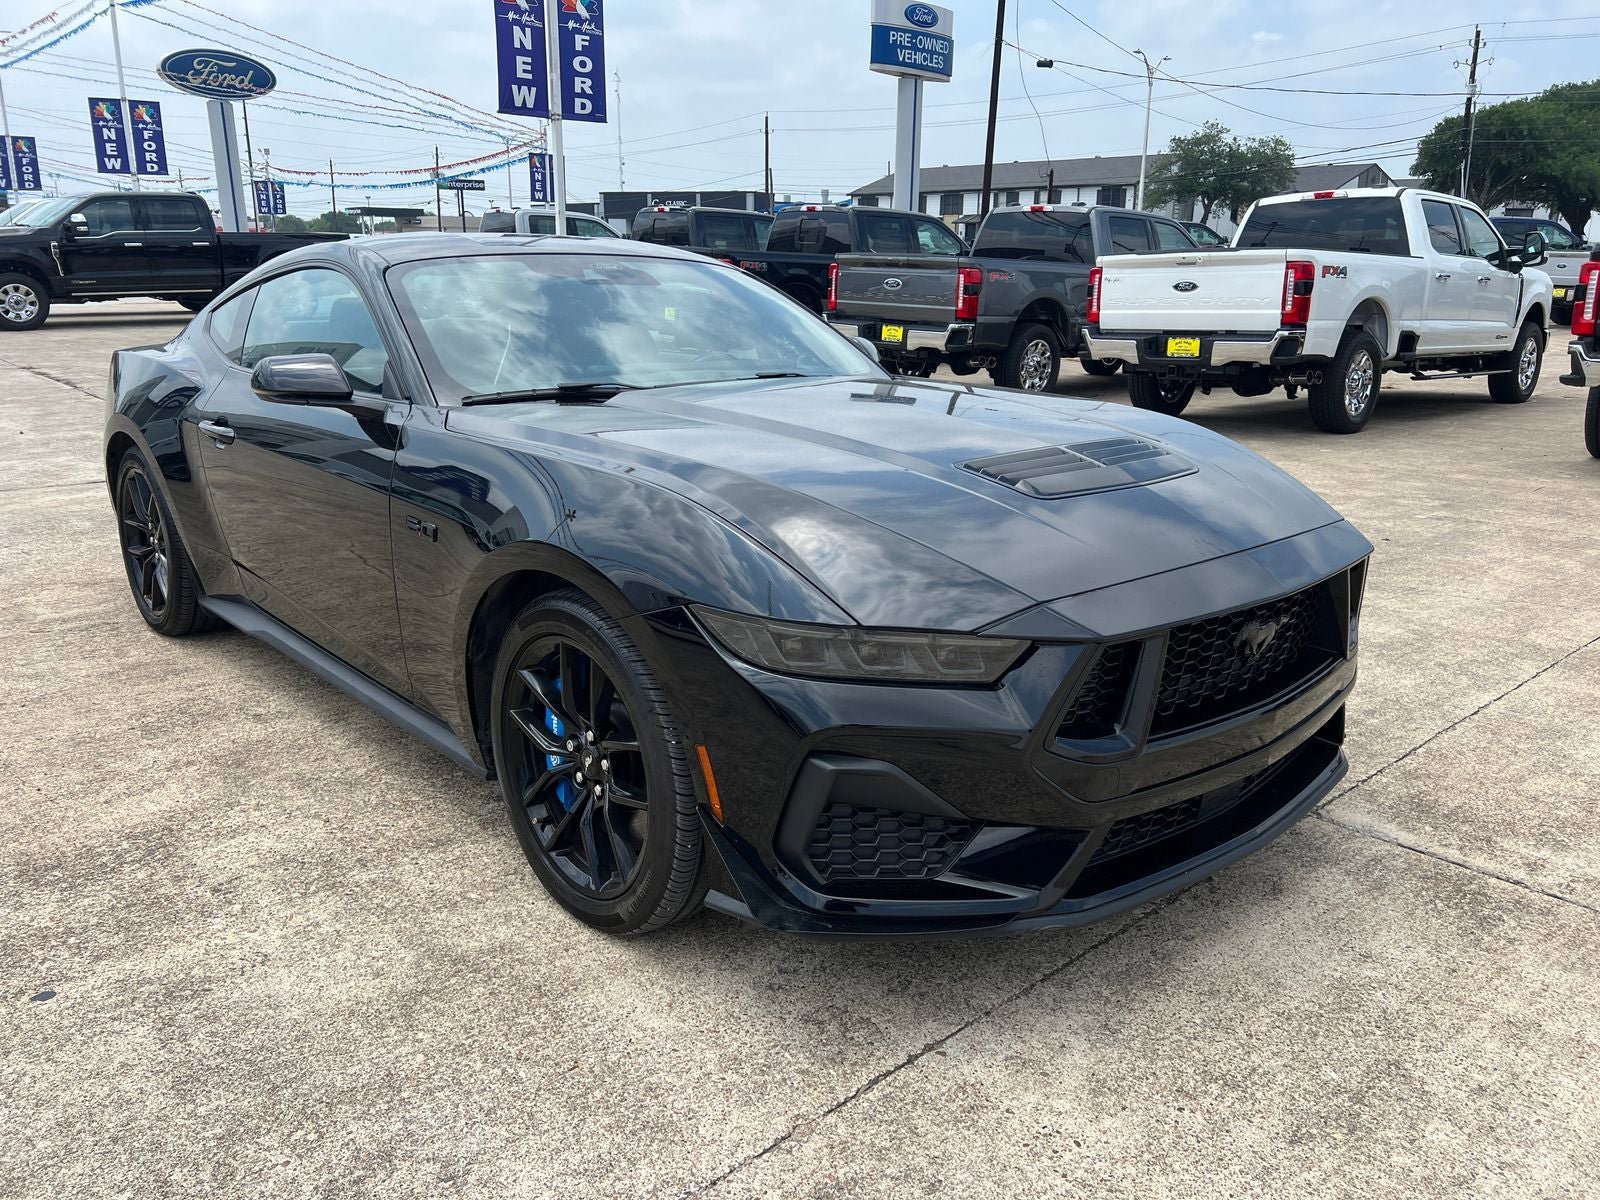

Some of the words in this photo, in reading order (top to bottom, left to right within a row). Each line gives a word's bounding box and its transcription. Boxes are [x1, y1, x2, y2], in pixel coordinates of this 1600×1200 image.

[914, 7, 933, 22] Ford
[511, 25, 537, 109] NEW
[897, 48, 944, 69] VEHICLES
[187, 58, 254, 89] Ford
[572, 34, 593, 115] FORD
[102, 128, 122, 170] NEW
[143, 130, 159, 172] FORD
[22, 157, 35, 189] FORD
[534, 172, 544, 200] NEW
[260, 193, 268, 213] NEW
[1321, 265, 1348, 277] FX4
[1177, 281, 1195, 291] Ford
